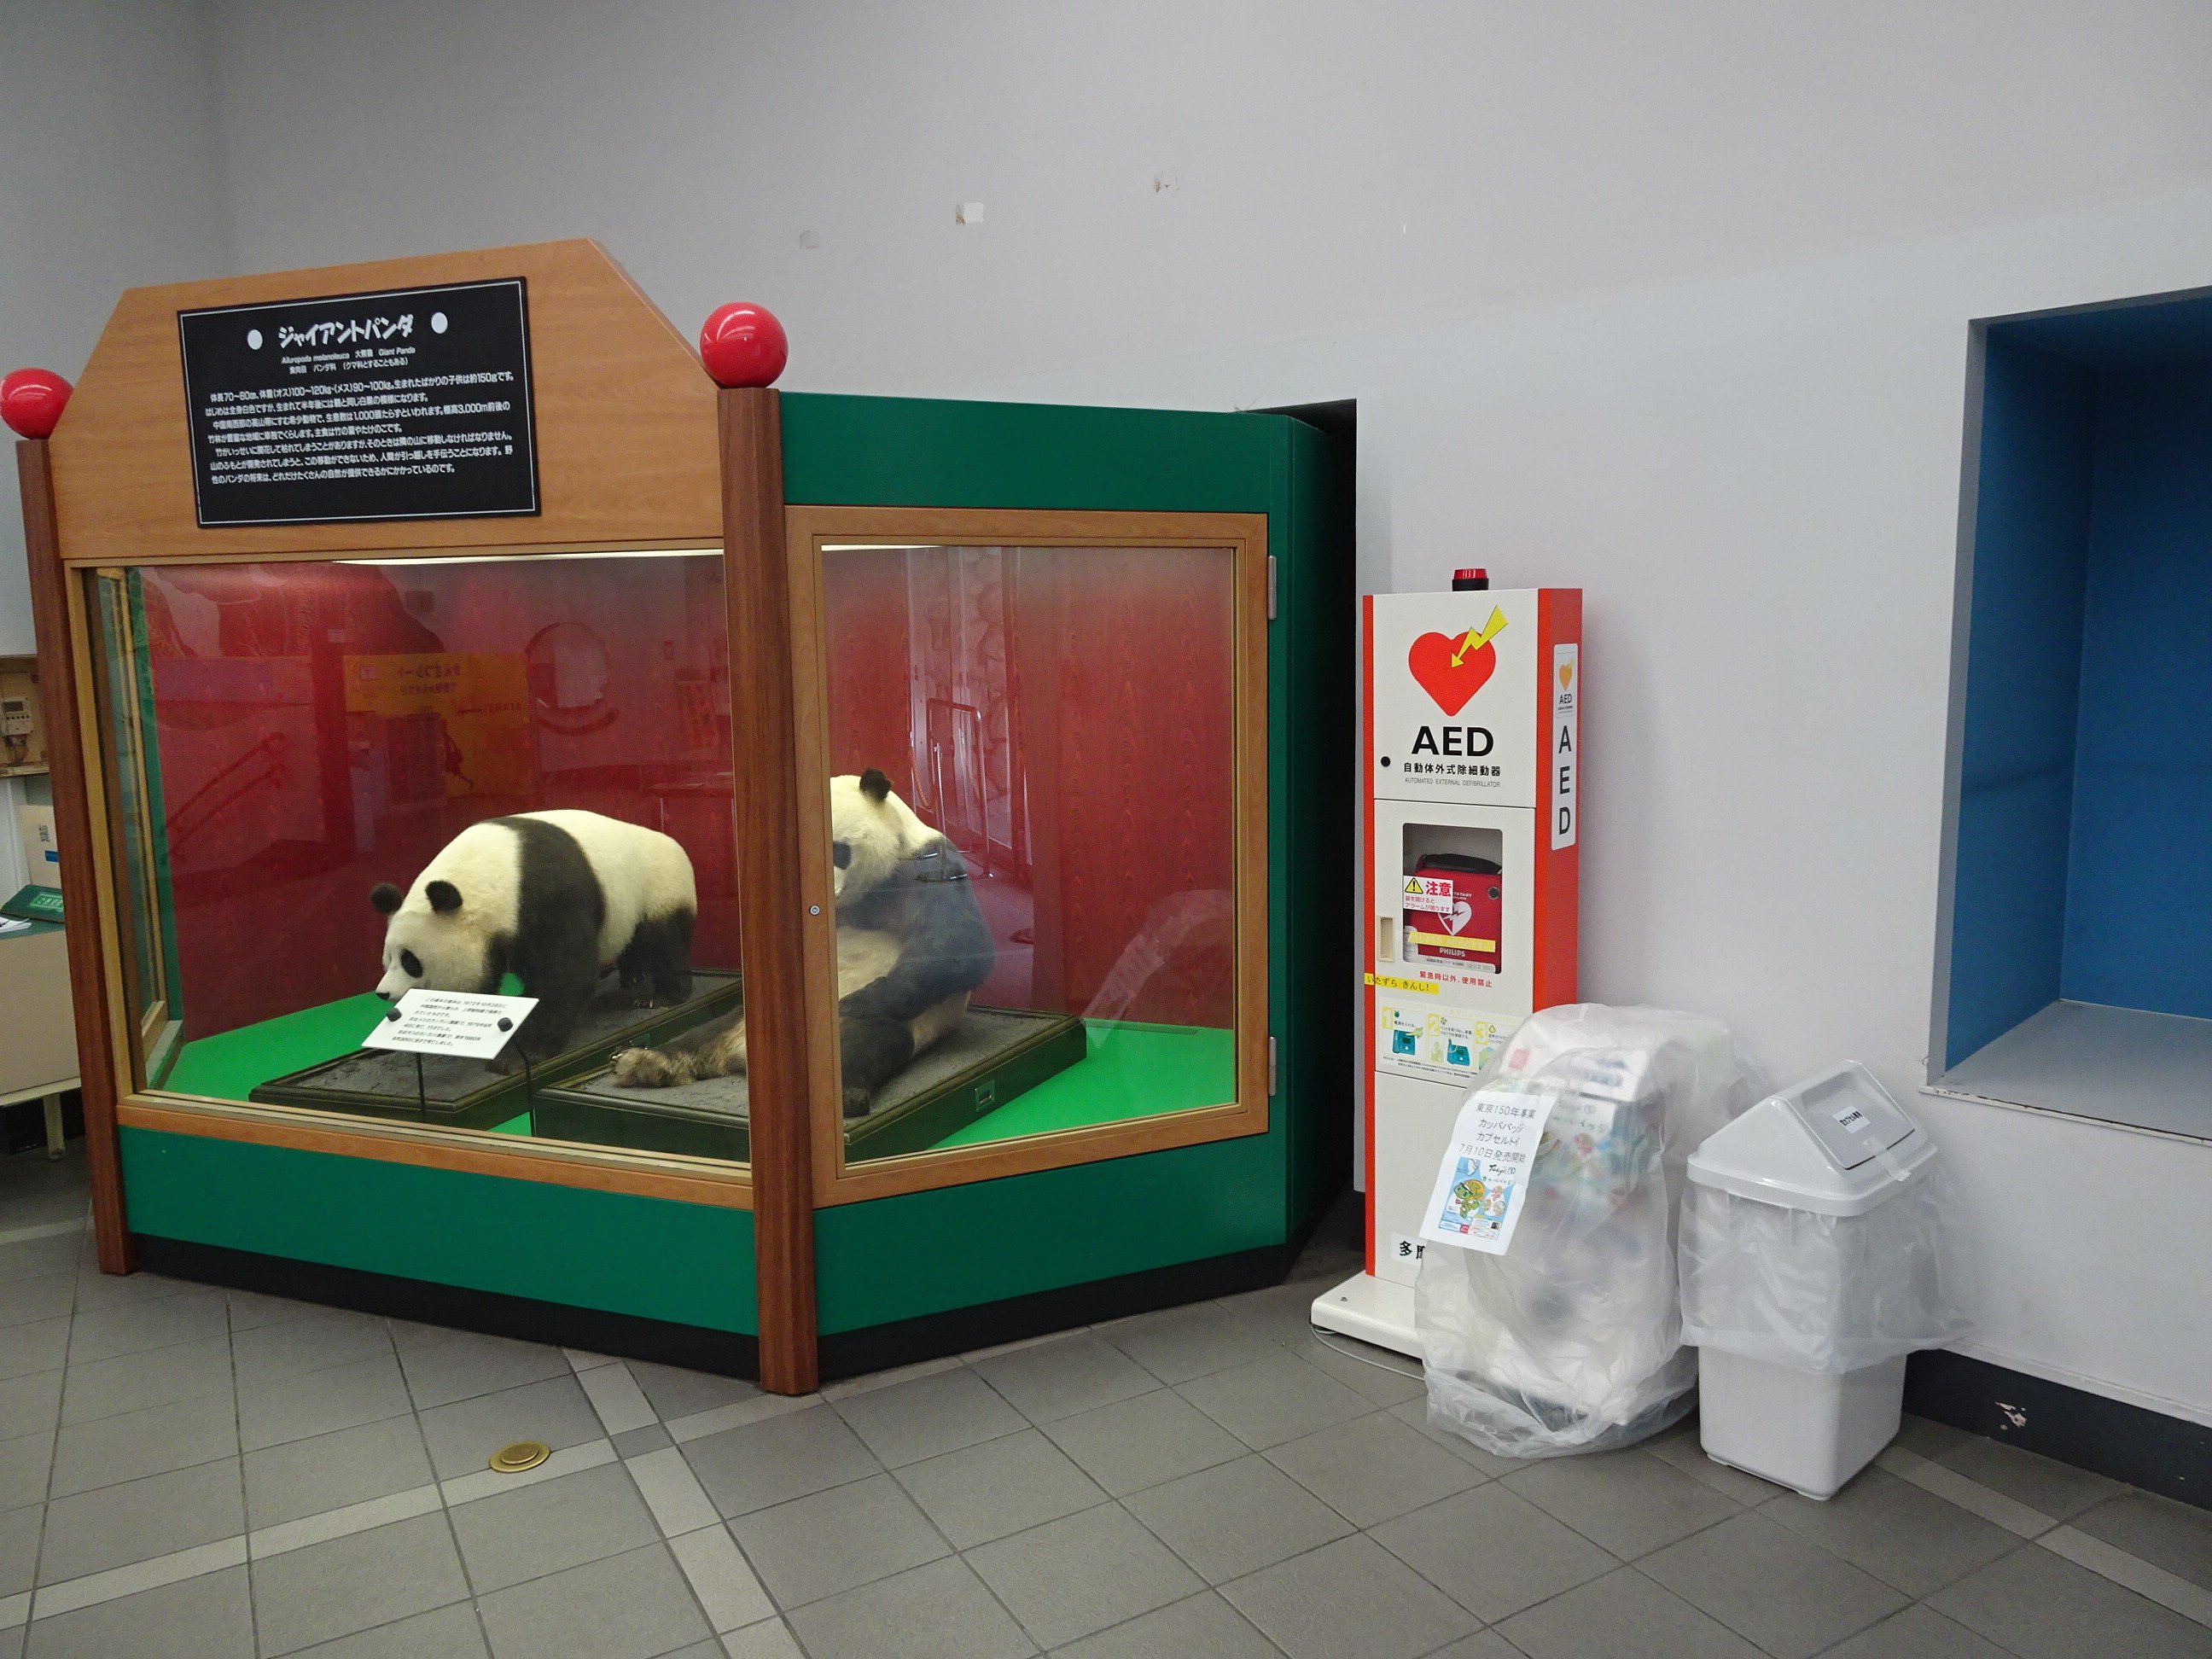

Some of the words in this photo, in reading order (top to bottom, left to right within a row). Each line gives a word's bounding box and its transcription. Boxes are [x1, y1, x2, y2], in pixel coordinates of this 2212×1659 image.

[278, 314, 413, 347] ジャイアントパンダ
[1559, 693, 1572, 705] AED
[1411, 725, 1494, 757] AED
[1403, 762, 1501, 777] 自動体外式除細動器
[1425, 881, 1452, 898] 注意
[1439, 947, 1466, 958] PHILIPS
[1367, 975, 1397, 987] いたずら
[1382, 1009, 1392, 1028] 1
[1429, 1015, 1440, 1035] 2
[1476, 1102, 1537, 1119] 東京150年事業
[1476, 1132, 1520, 1147] カプセルトイ
[1458, 1144, 1527, 1163] 7月10日発売開始
